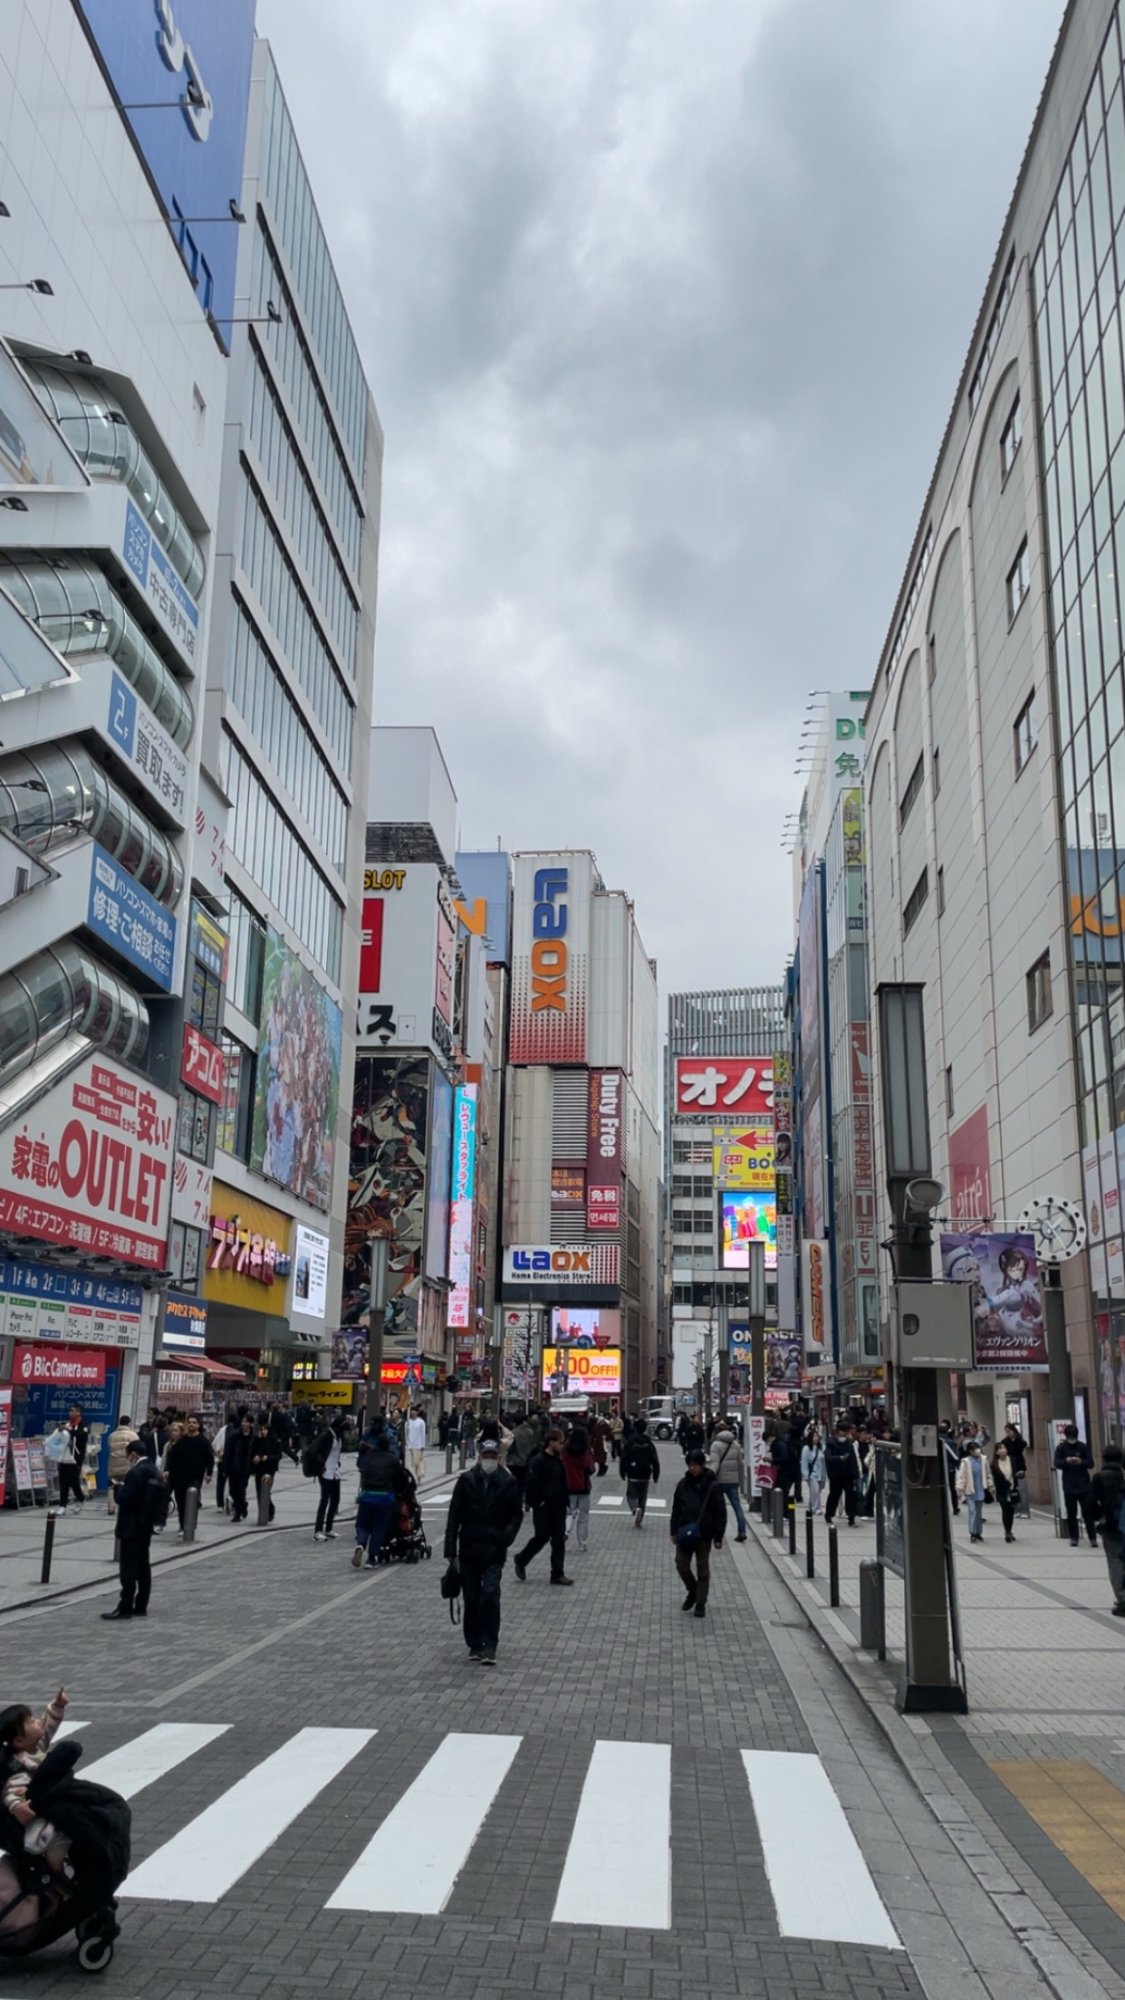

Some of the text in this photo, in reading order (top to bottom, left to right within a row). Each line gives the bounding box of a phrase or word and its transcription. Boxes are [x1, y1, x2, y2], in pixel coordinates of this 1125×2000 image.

[150, 571, 196, 656] 中古専門店
[113, 686, 129, 739] 2F
[600, 1074, 619, 1157] Duty Free
[511, 1271, 591, 1281] Home Electronics Store
[986, 1336, 1042, 1346] エヴァンゲリオン
[33, 1356, 81, 1378] BicCamera
